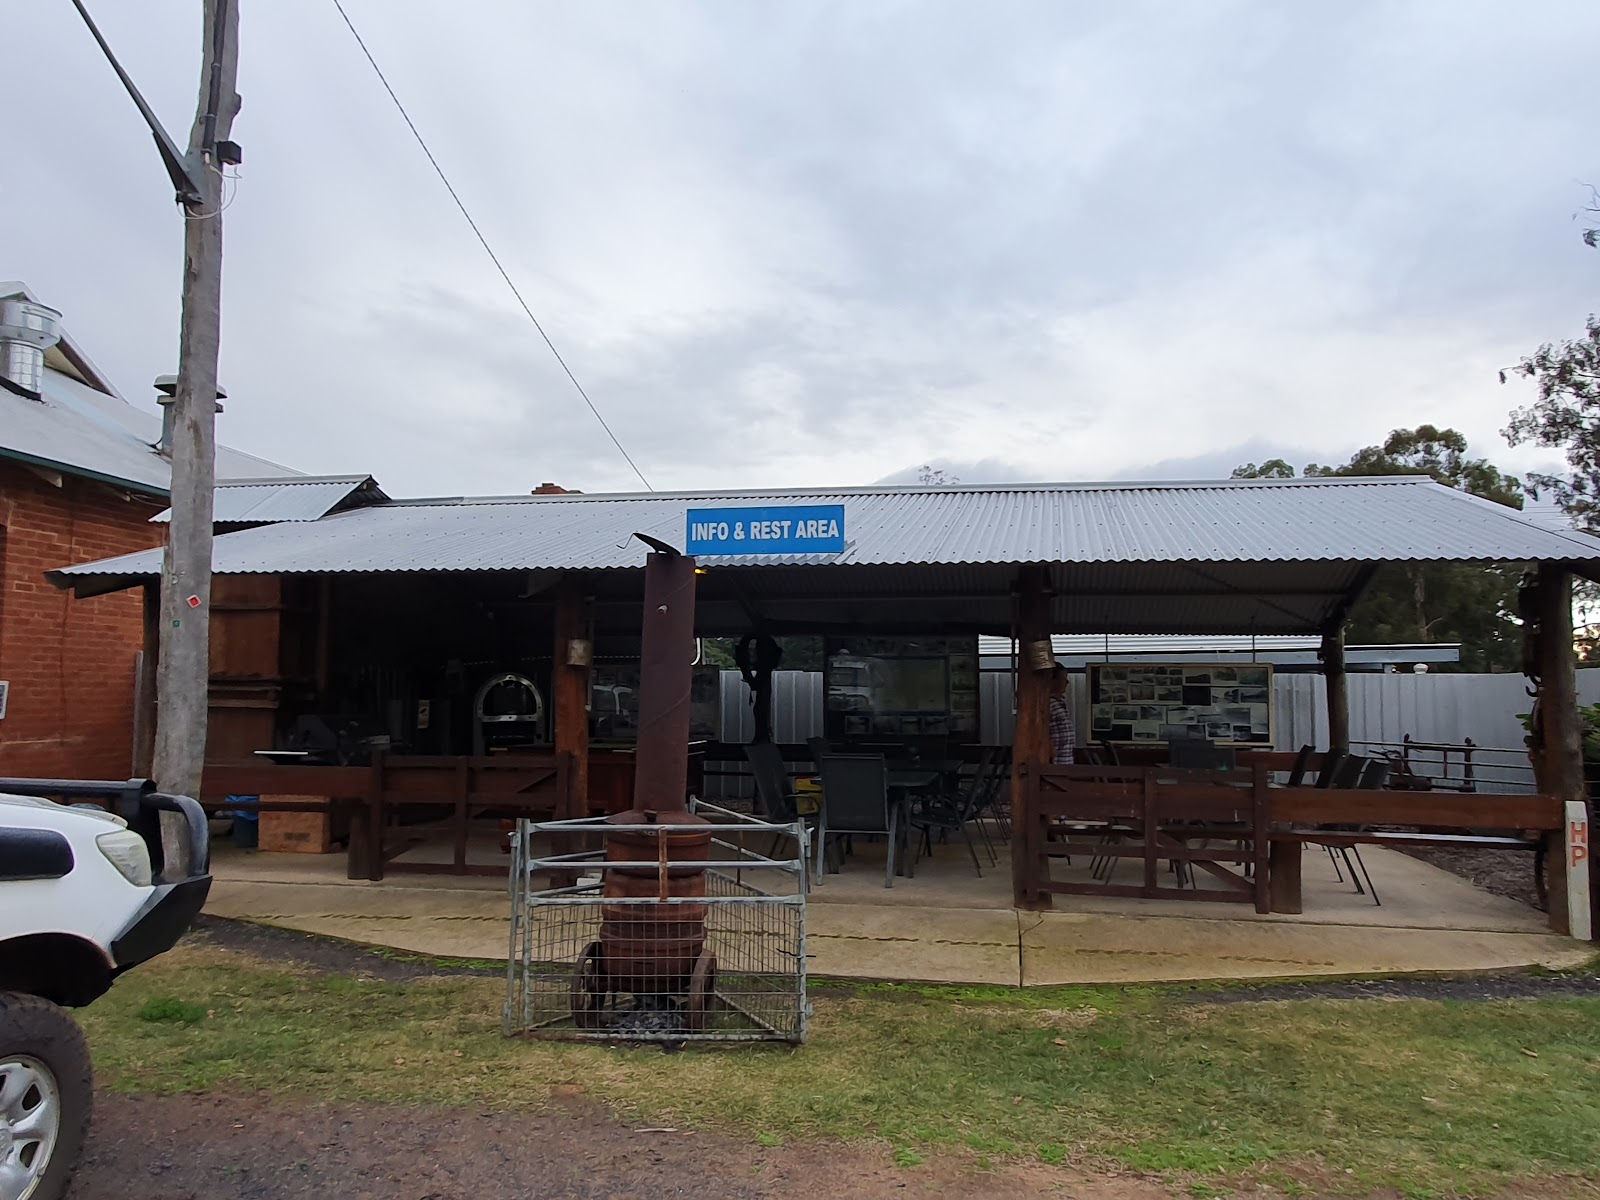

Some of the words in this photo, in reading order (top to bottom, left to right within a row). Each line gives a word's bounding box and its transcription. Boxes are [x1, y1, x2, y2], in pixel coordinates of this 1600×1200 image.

[691, 522, 729, 541] INFO
[733, 521, 745, 540] &
[750, 520, 791, 540] REST
[795, 519, 839, 539] AREA
